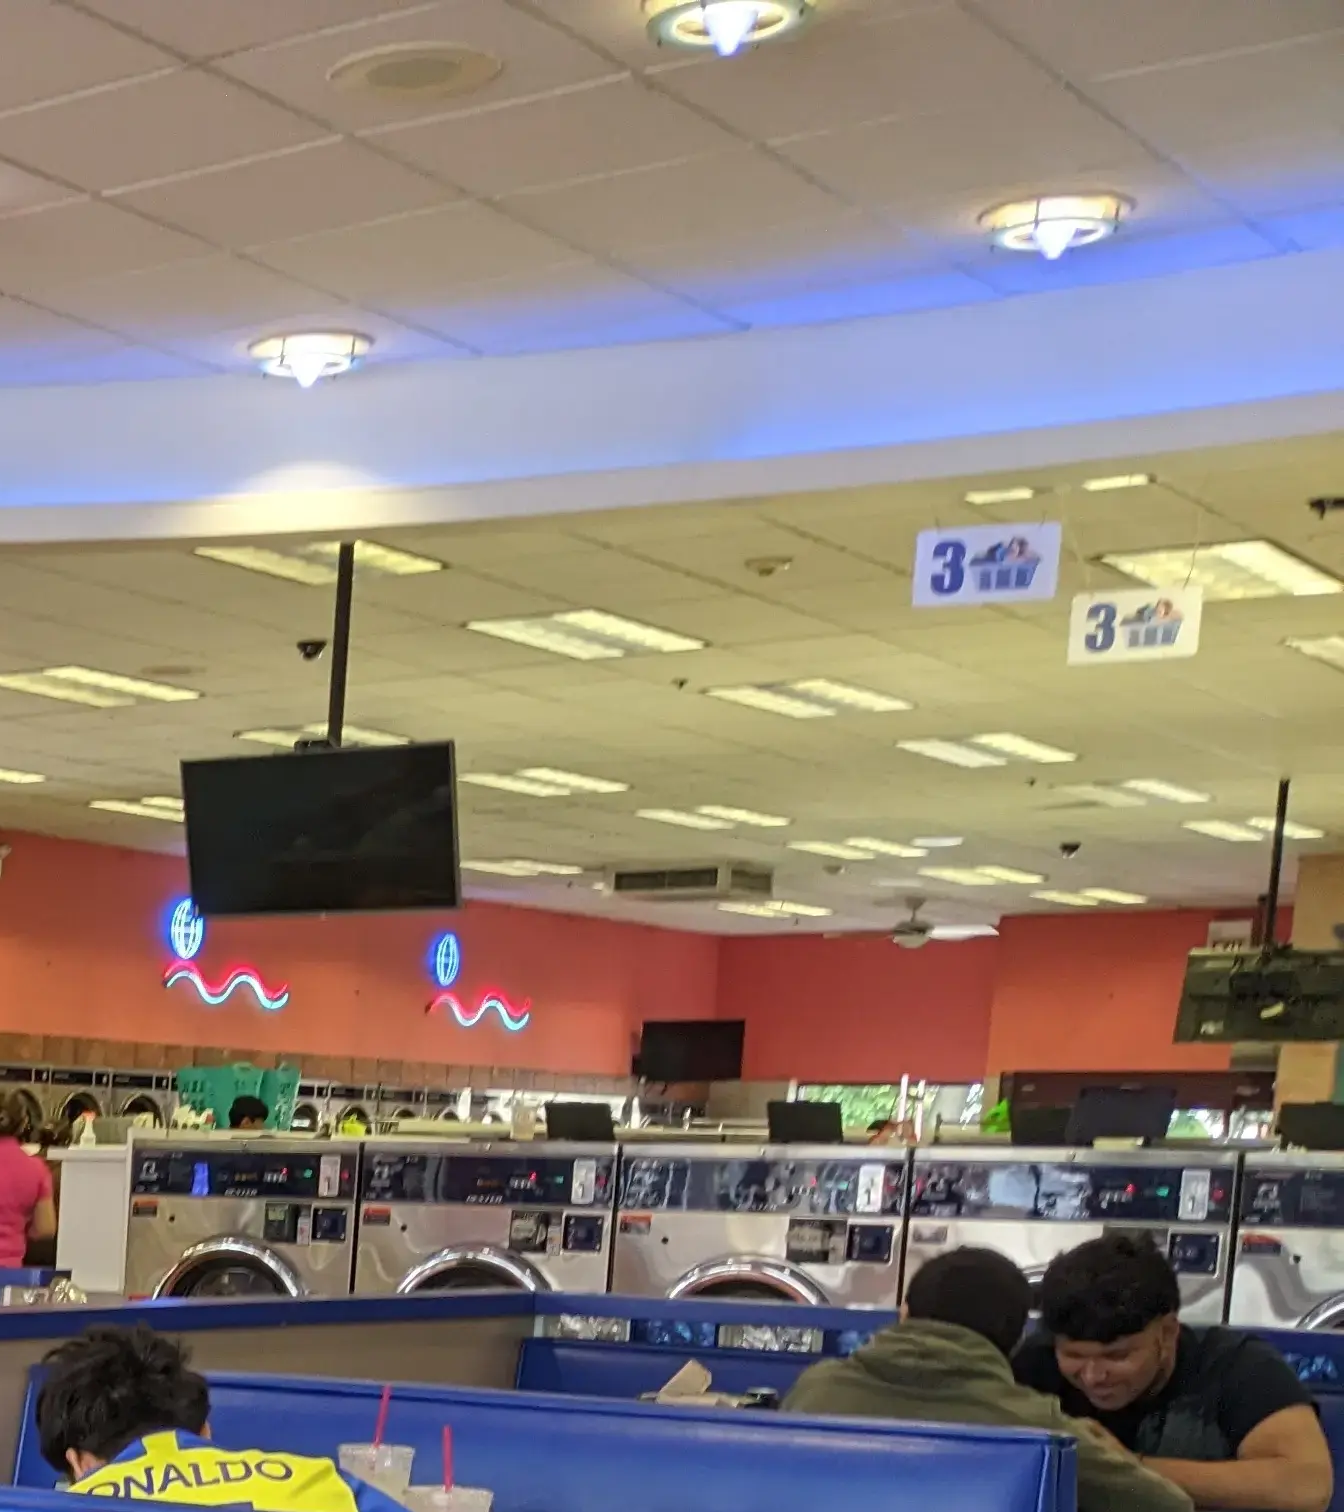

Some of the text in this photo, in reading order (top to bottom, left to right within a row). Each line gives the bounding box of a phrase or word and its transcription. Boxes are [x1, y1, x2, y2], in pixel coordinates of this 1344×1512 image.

[930, 540, 966, 595] 3
[1084, 603, 1116, 652] 3
[86, 1460, 293, 1499] ONALDO
